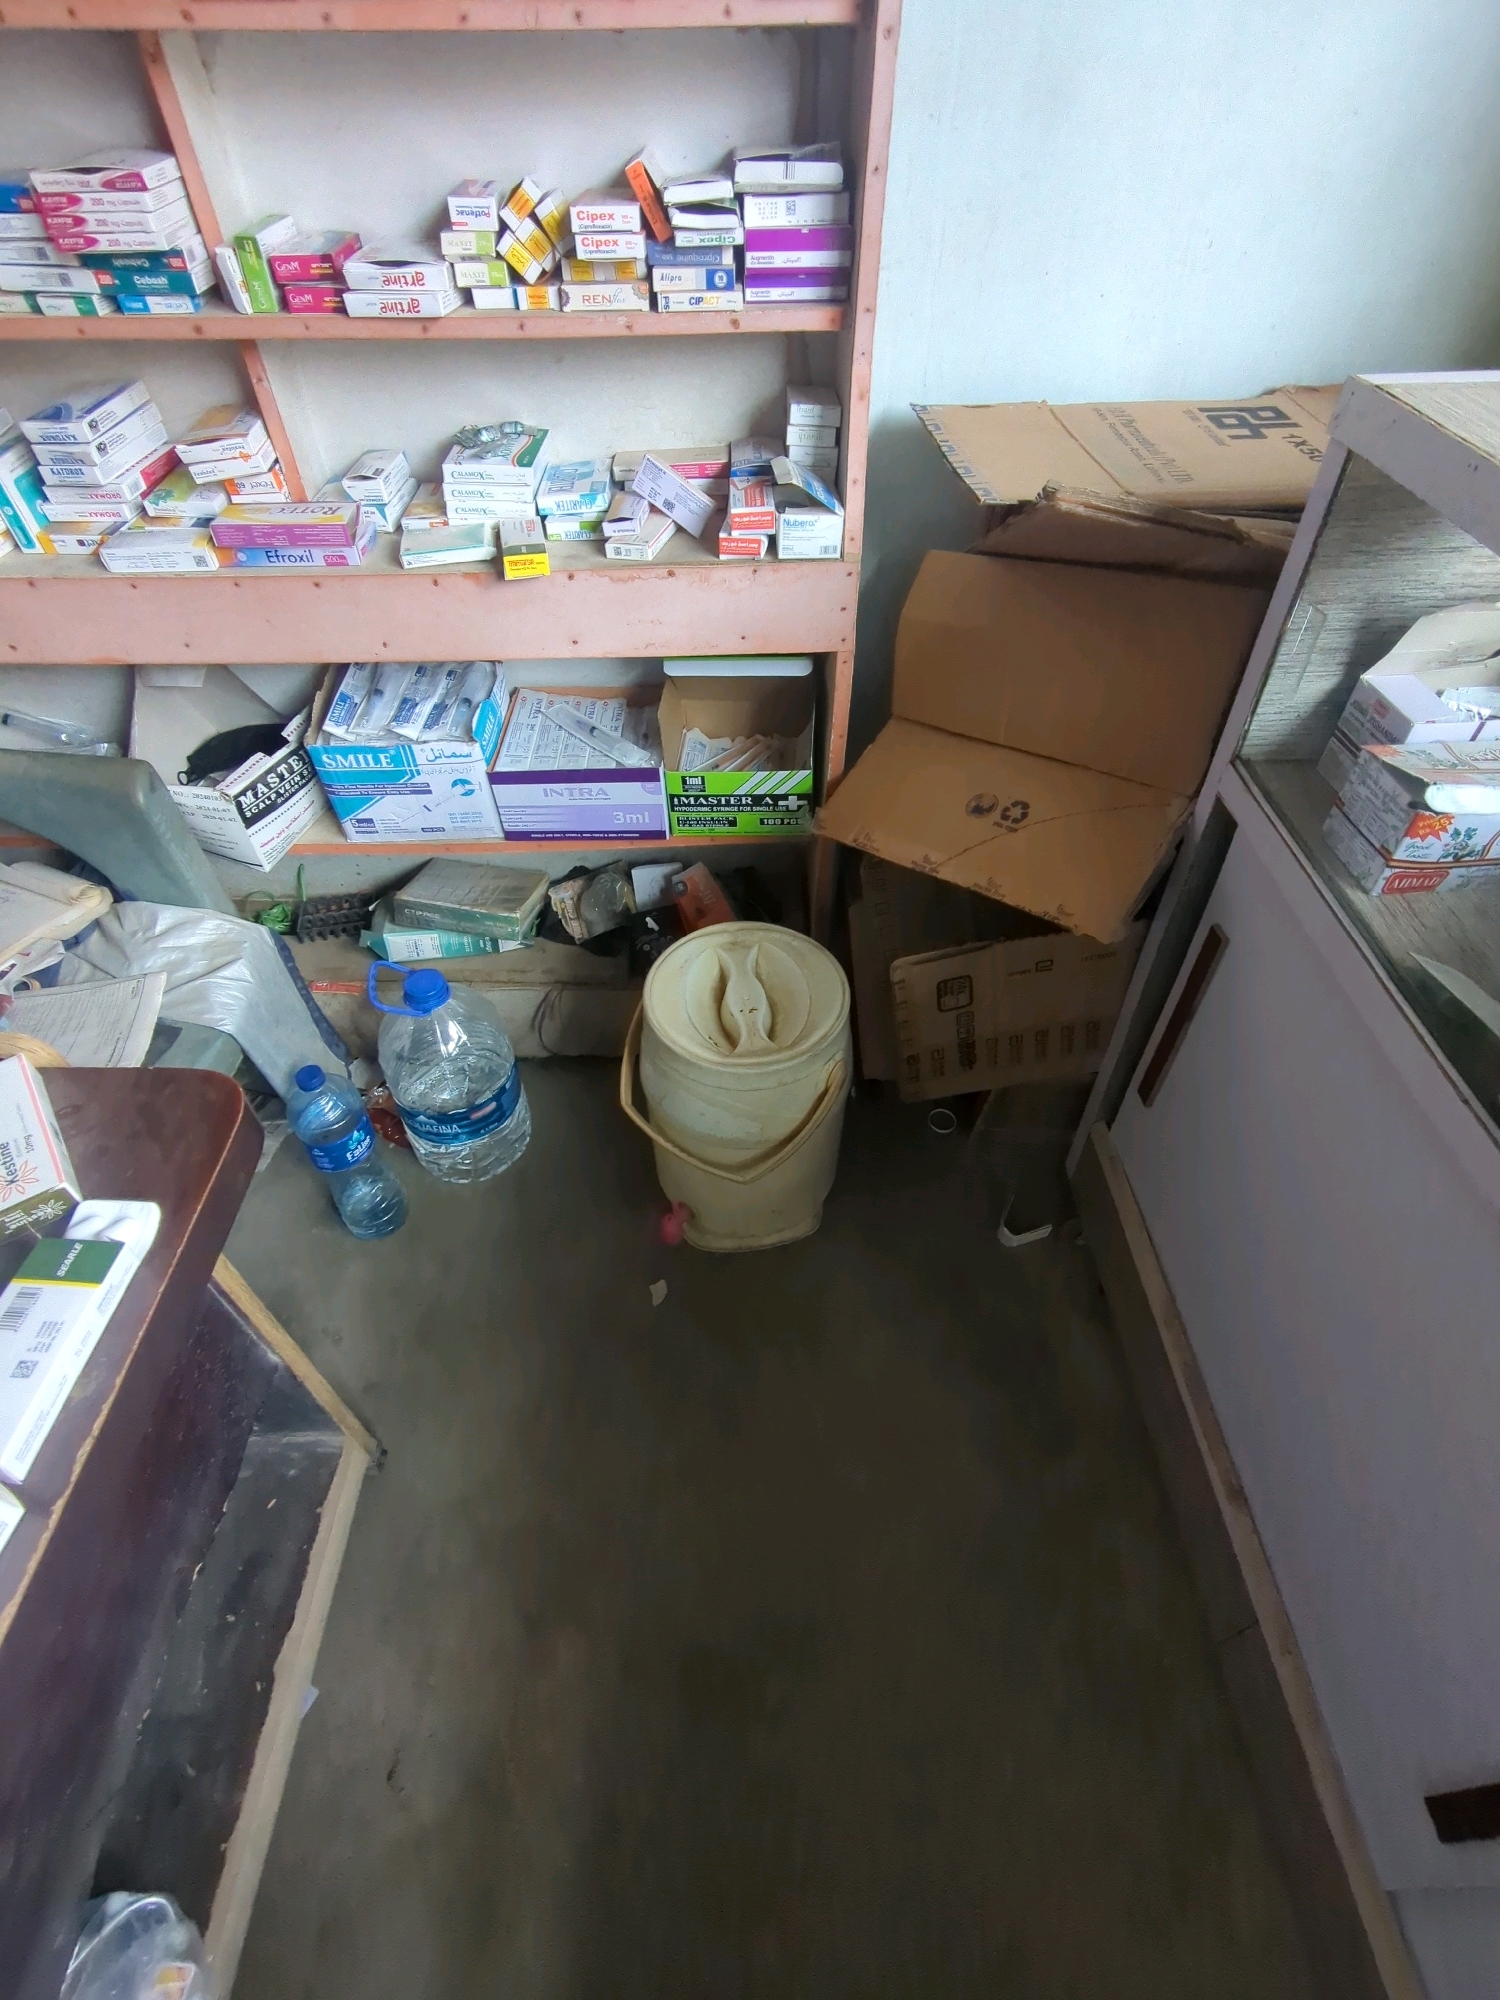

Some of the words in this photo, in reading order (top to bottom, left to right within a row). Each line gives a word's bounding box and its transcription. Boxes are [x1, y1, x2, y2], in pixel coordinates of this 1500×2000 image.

[576, 210, 615, 223] Cipex
[581, 237, 620, 249] Cipex
[698, 234, 736, 244] Cipex
[660, 272, 682, 284] Alipro
[689, 296, 721, 306] CIPACT
[265, 550, 314, 564] Efroxil
[330, 700, 346, 722] SMILE
[322, 752, 394, 769] SMILE
[685, 776, 702, 785] 1ml
[245, 794, 277, 818] SCALP
[279, 774, 302, 796] VEIN
[277, 786, 298, 804] BLISTER
[542, 786, 610, 798] INTRA
[680, 796, 752, 805] MASTER
[762, 796, 774, 804] A
[613, 812, 650, 824] 3ml
[1433, 818, 1449, 830] 25
[1390, 876, 1440, 888] AHMAD
[408, 1117, 460, 1134] QUAFINA
[24, 1134, 34, 1154] 10mg
[57, 1242, 83, 1278] SEARLE
